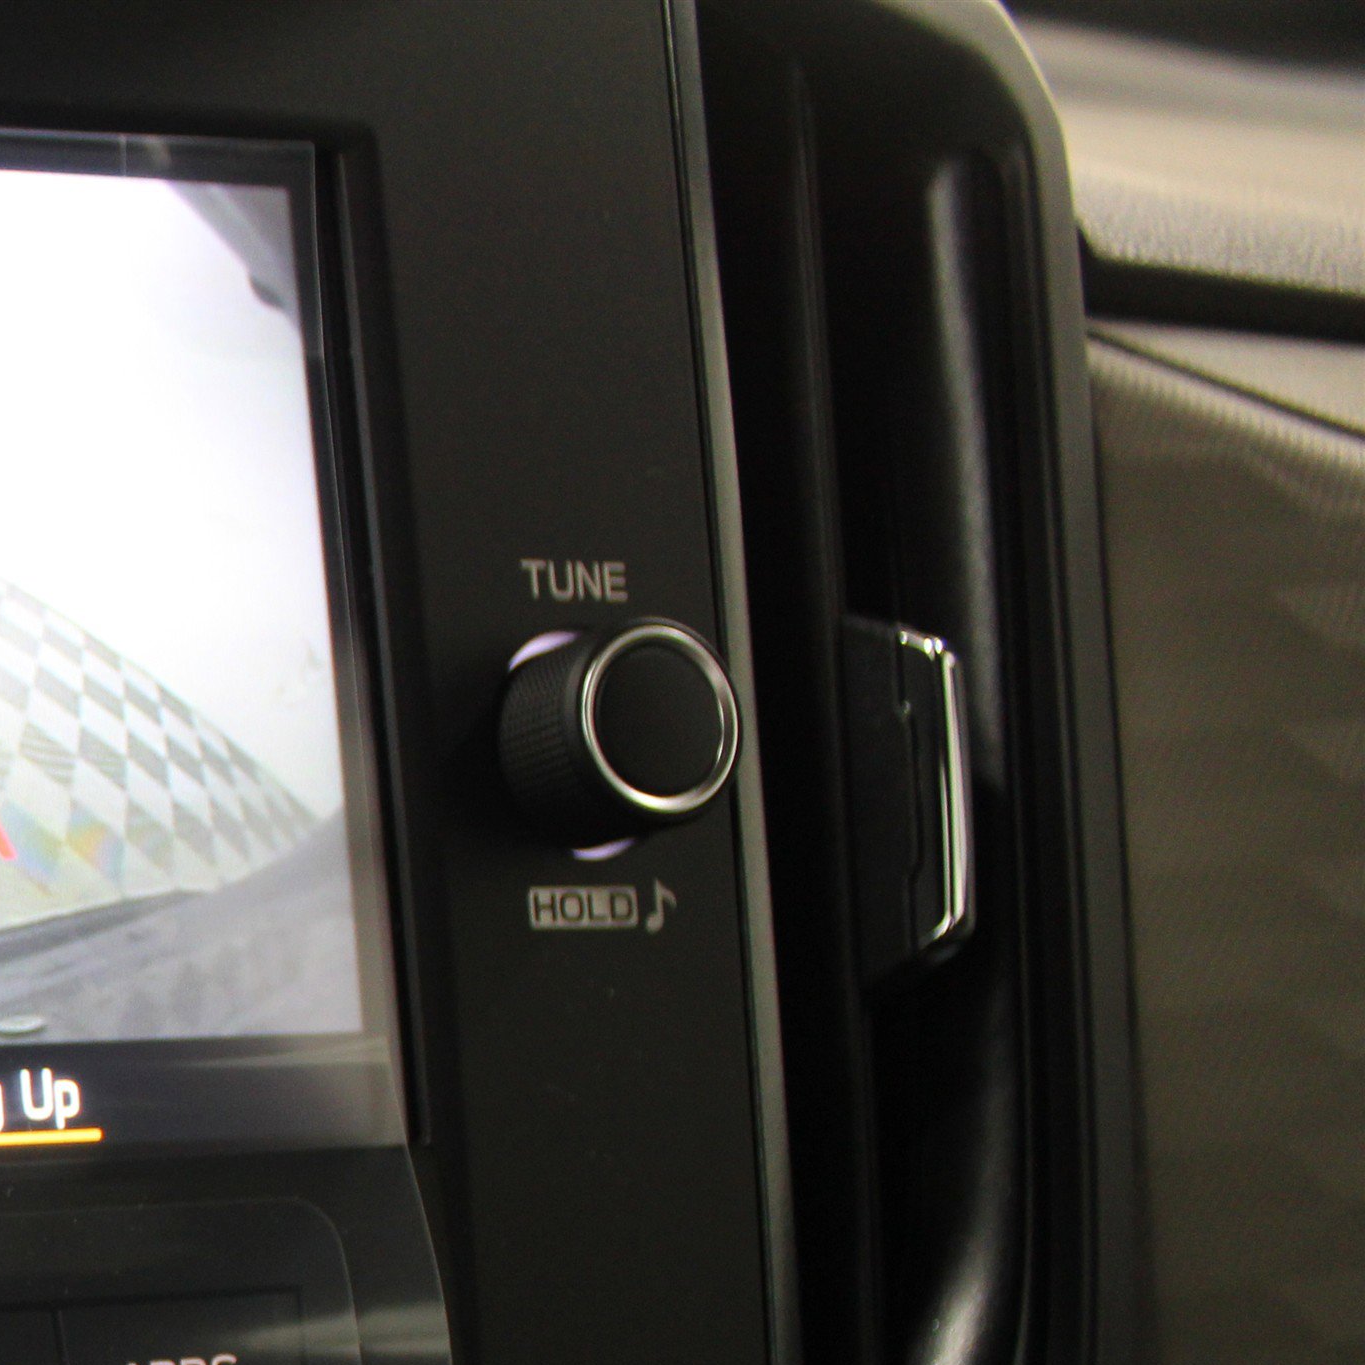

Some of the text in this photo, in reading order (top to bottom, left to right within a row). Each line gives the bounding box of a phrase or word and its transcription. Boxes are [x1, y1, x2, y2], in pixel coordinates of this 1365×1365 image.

[519, 557, 630, 602] TUNE
[533, 890, 635, 924] HOLD
[19, 1067, 81, 1129] Up
